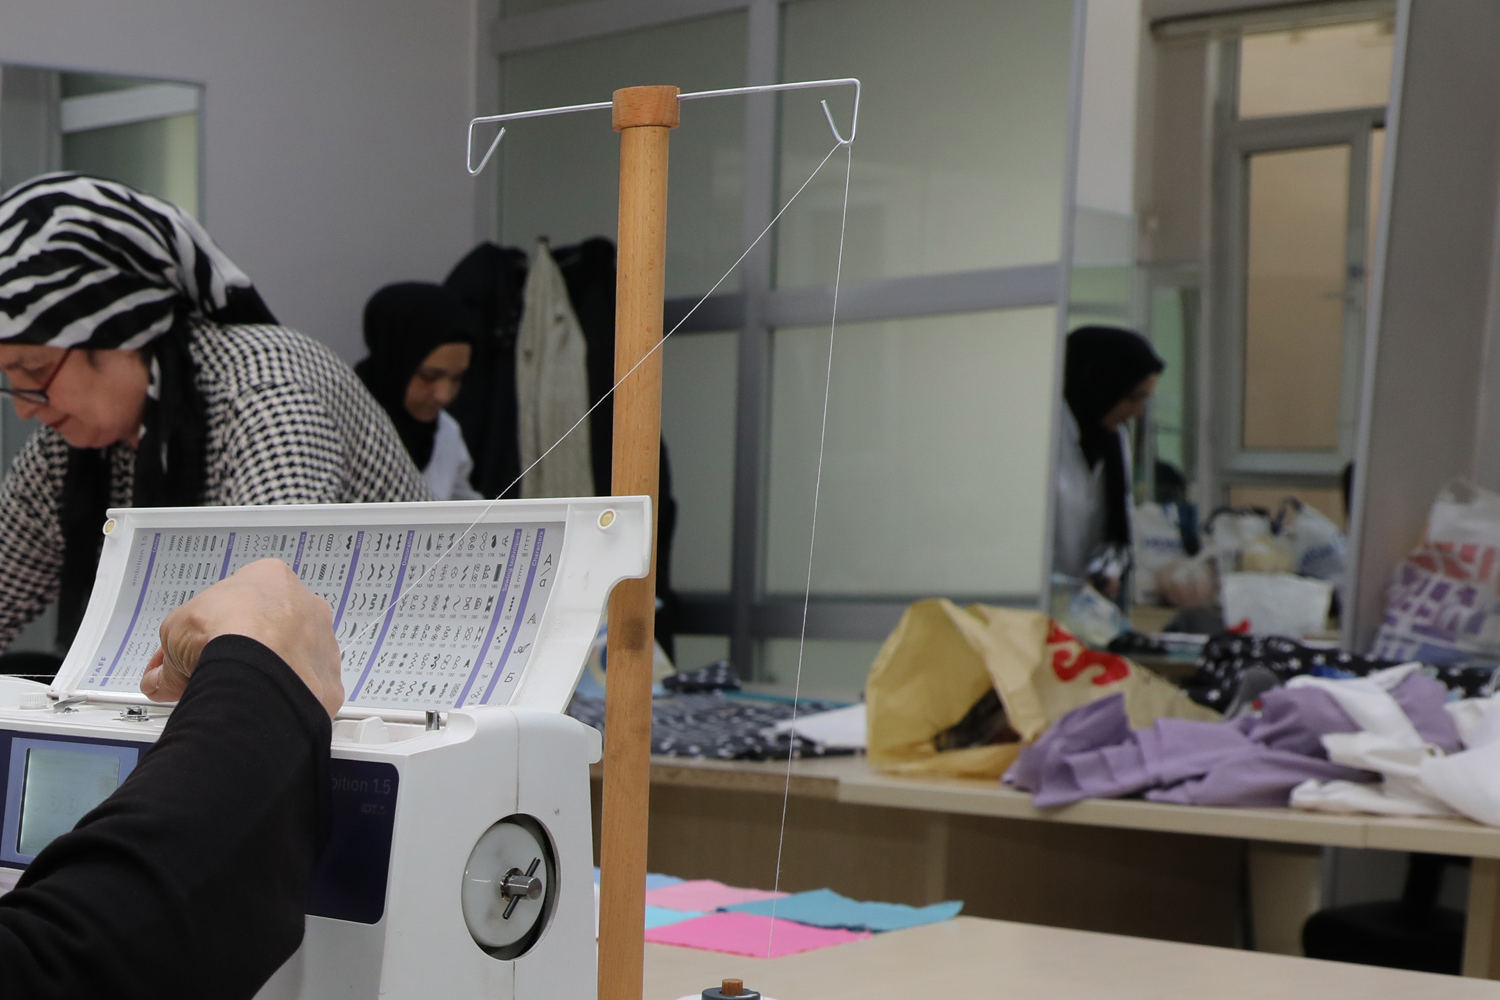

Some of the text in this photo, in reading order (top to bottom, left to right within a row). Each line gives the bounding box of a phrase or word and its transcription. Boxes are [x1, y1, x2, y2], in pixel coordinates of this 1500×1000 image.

[531, 531, 544, 567] Characters
[88, 656, 107, 684] PFAFF
[373, 777, 392, 795] 1.5
